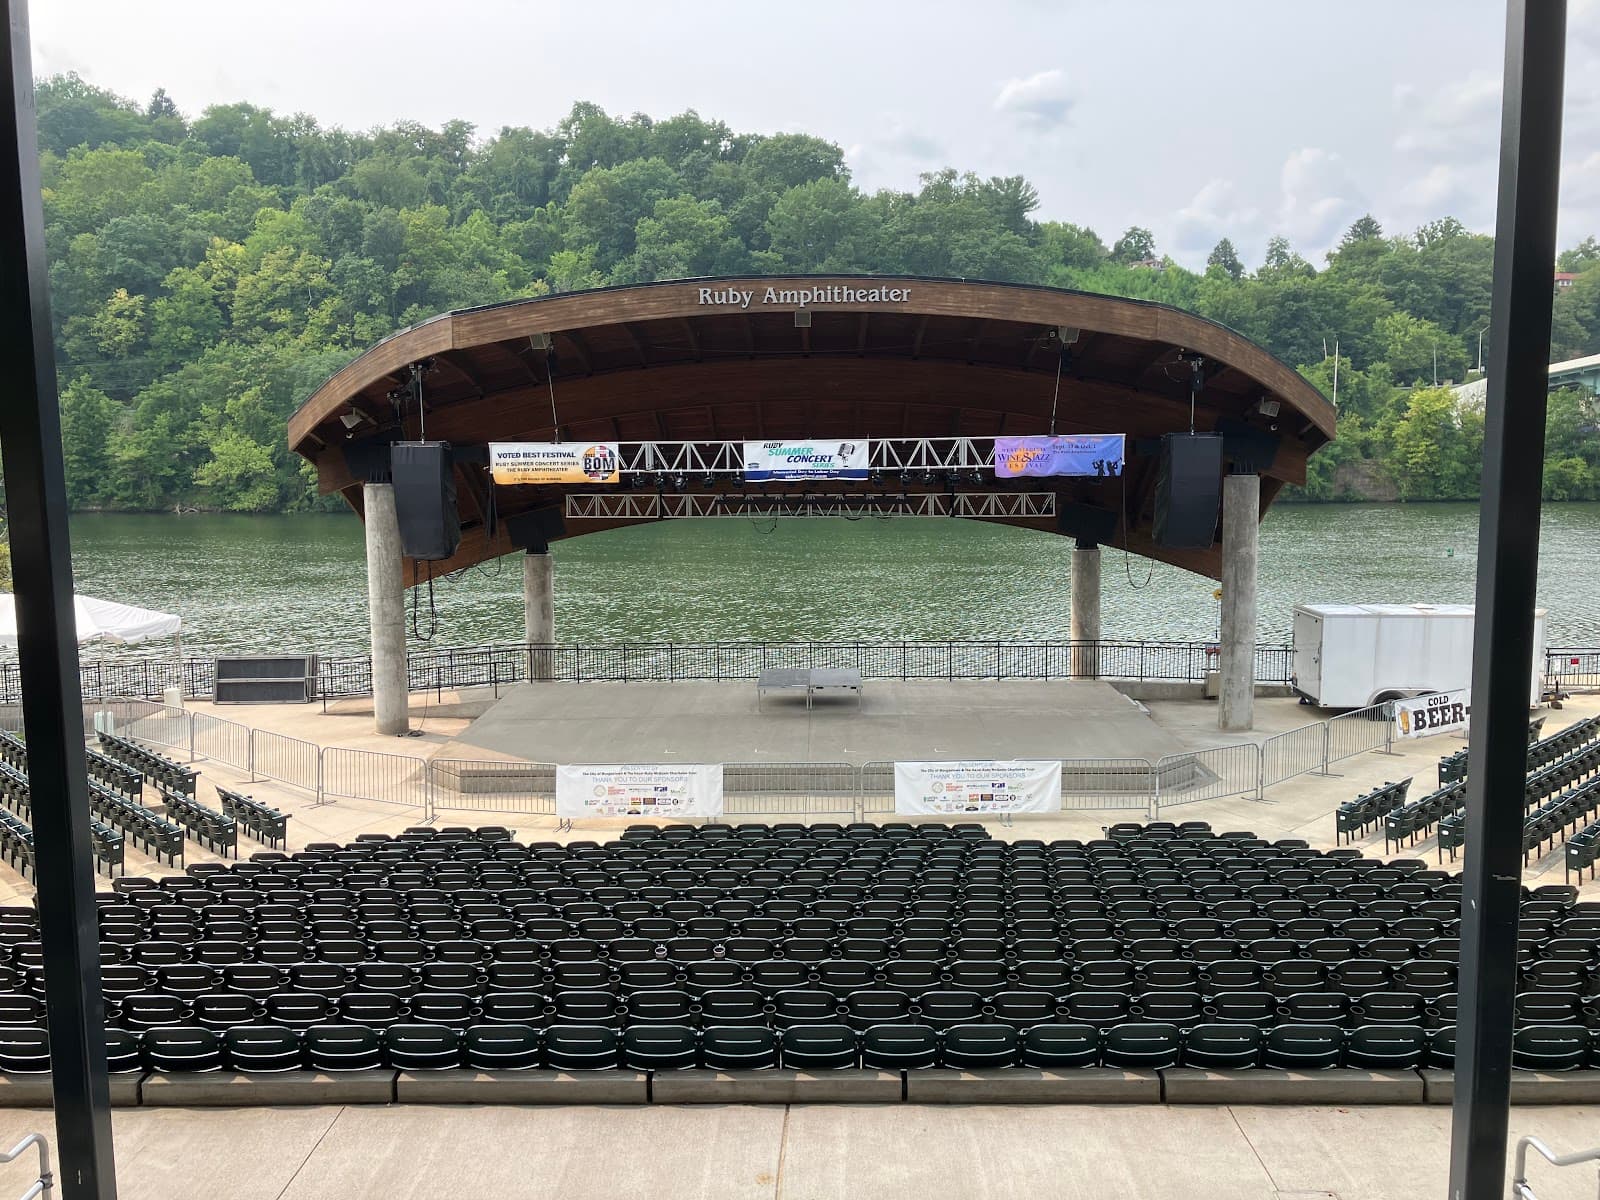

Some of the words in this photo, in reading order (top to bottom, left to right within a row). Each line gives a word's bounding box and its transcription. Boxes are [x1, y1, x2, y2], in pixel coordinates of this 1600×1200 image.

[698, 287, 753, 308] Ruby
[763, 285, 912, 307] Amphitheater
[768, 448, 814, 456] SUMMER
[585, 457, 615, 470] BOM
[1428, 696, 1448, 706] COLD
[1413, 702, 1464, 731] BEER
